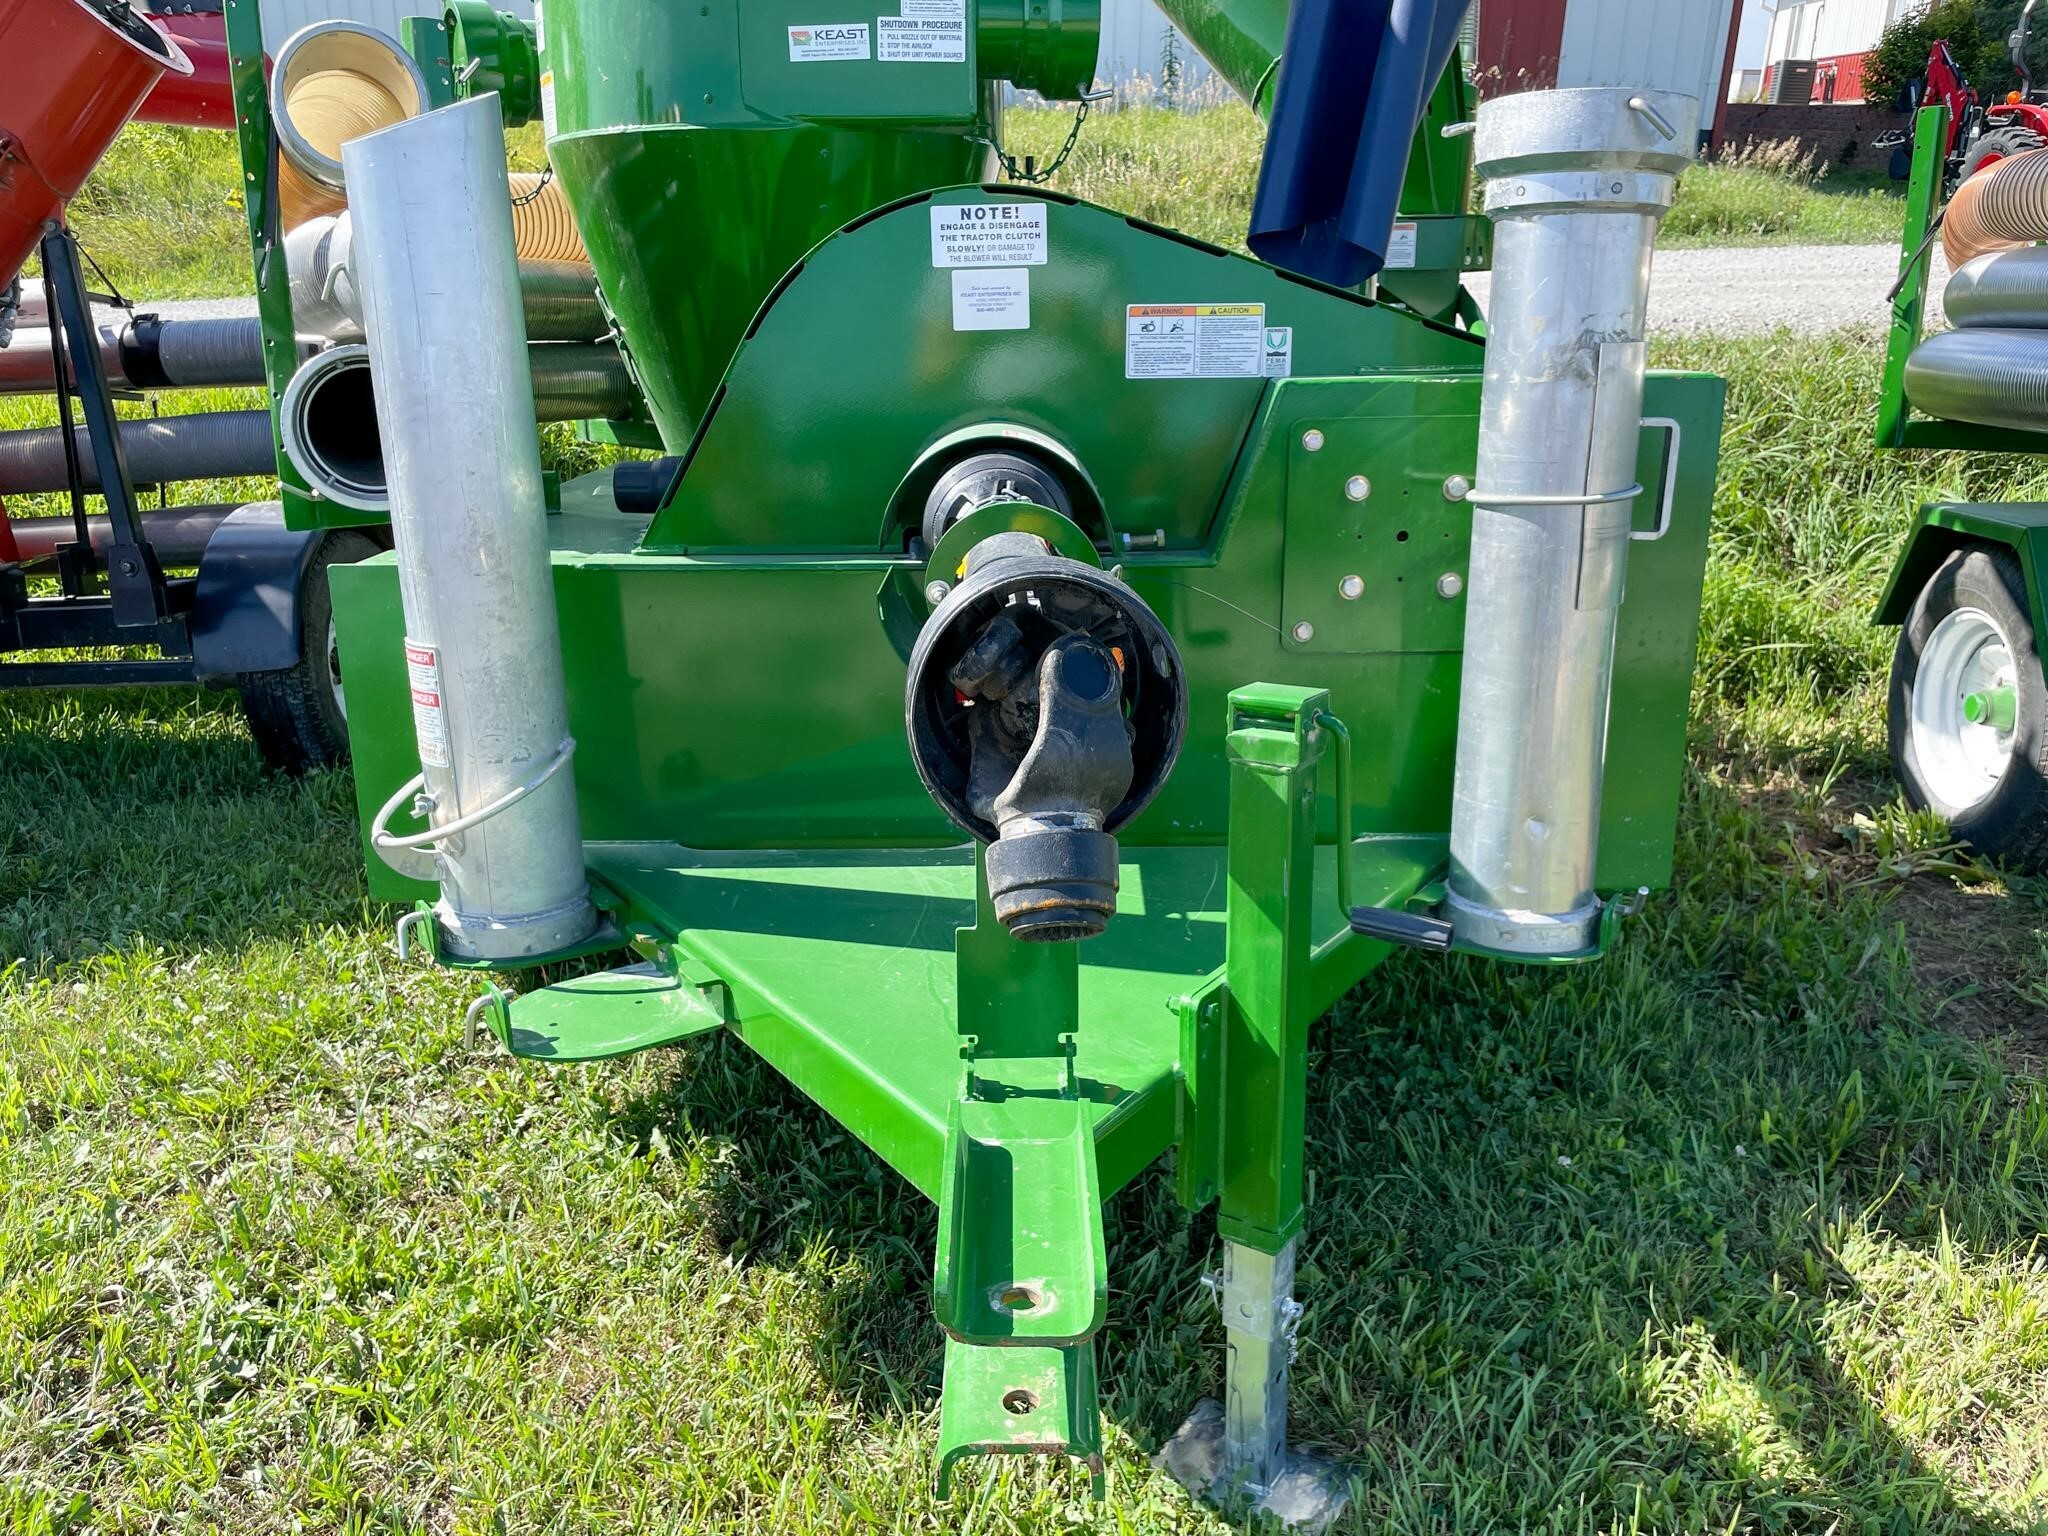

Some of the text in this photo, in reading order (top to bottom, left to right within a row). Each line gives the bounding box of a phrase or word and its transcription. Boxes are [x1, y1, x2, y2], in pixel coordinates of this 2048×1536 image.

[880, 20, 962, 29] SHUTDOWN PROCEDURE
[814, 28, 867, 40] KEAST
[960, 206, 1019, 220] NOTE!
[940, 223, 977, 231] ENGAGE
[989, 221, 1040, 229] DISENGAGE
[960, 233, 1003, 241] TRACTOR
[1005, 232, 1041, 240] CLUTCH
[946, 245, 985, 253] SLOWLY!
[963, 254, 990, 262] BLOWER
[1008, 253, 1032, 261] RESULT
